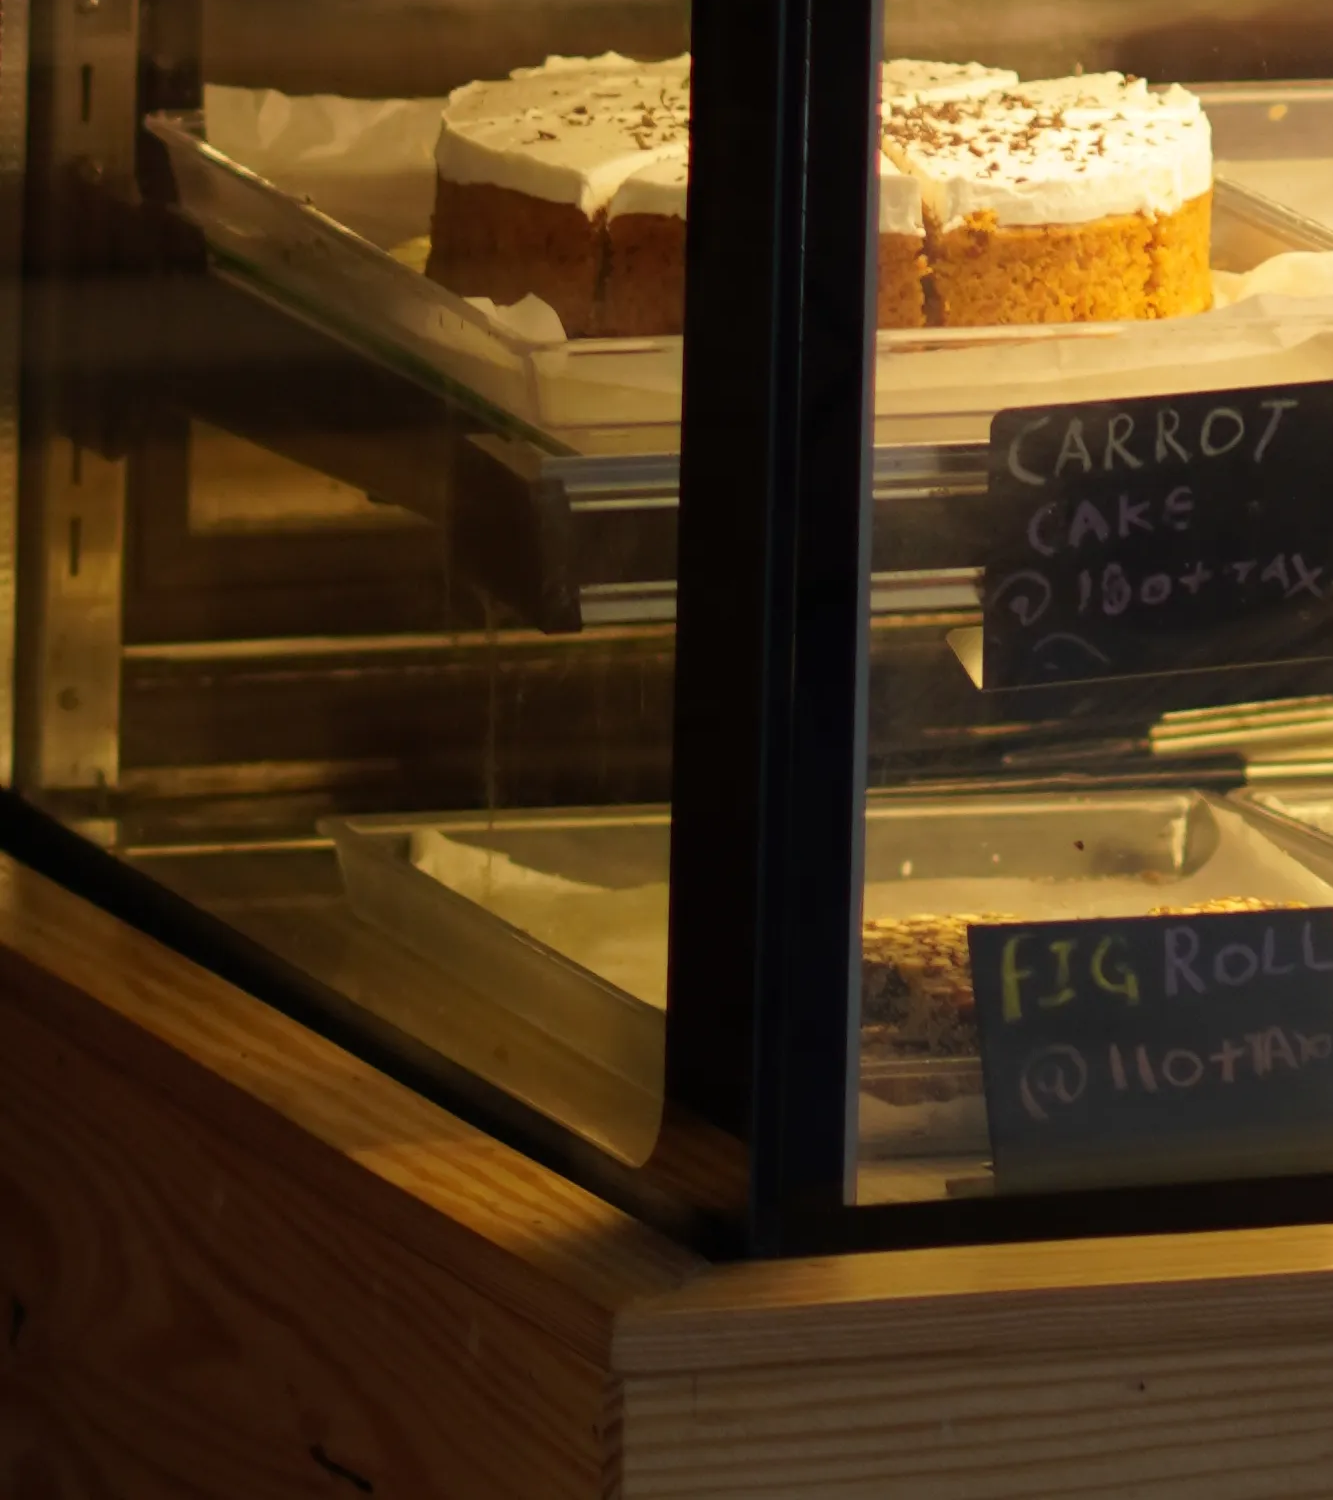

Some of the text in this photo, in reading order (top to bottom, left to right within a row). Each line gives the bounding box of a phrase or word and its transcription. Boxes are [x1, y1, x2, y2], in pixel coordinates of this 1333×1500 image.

[1007, 399, 1298, 485] CARROT
[1027, 485, 1195, 557] CAKE
[1002, 933, 1140, 1022] FIG
